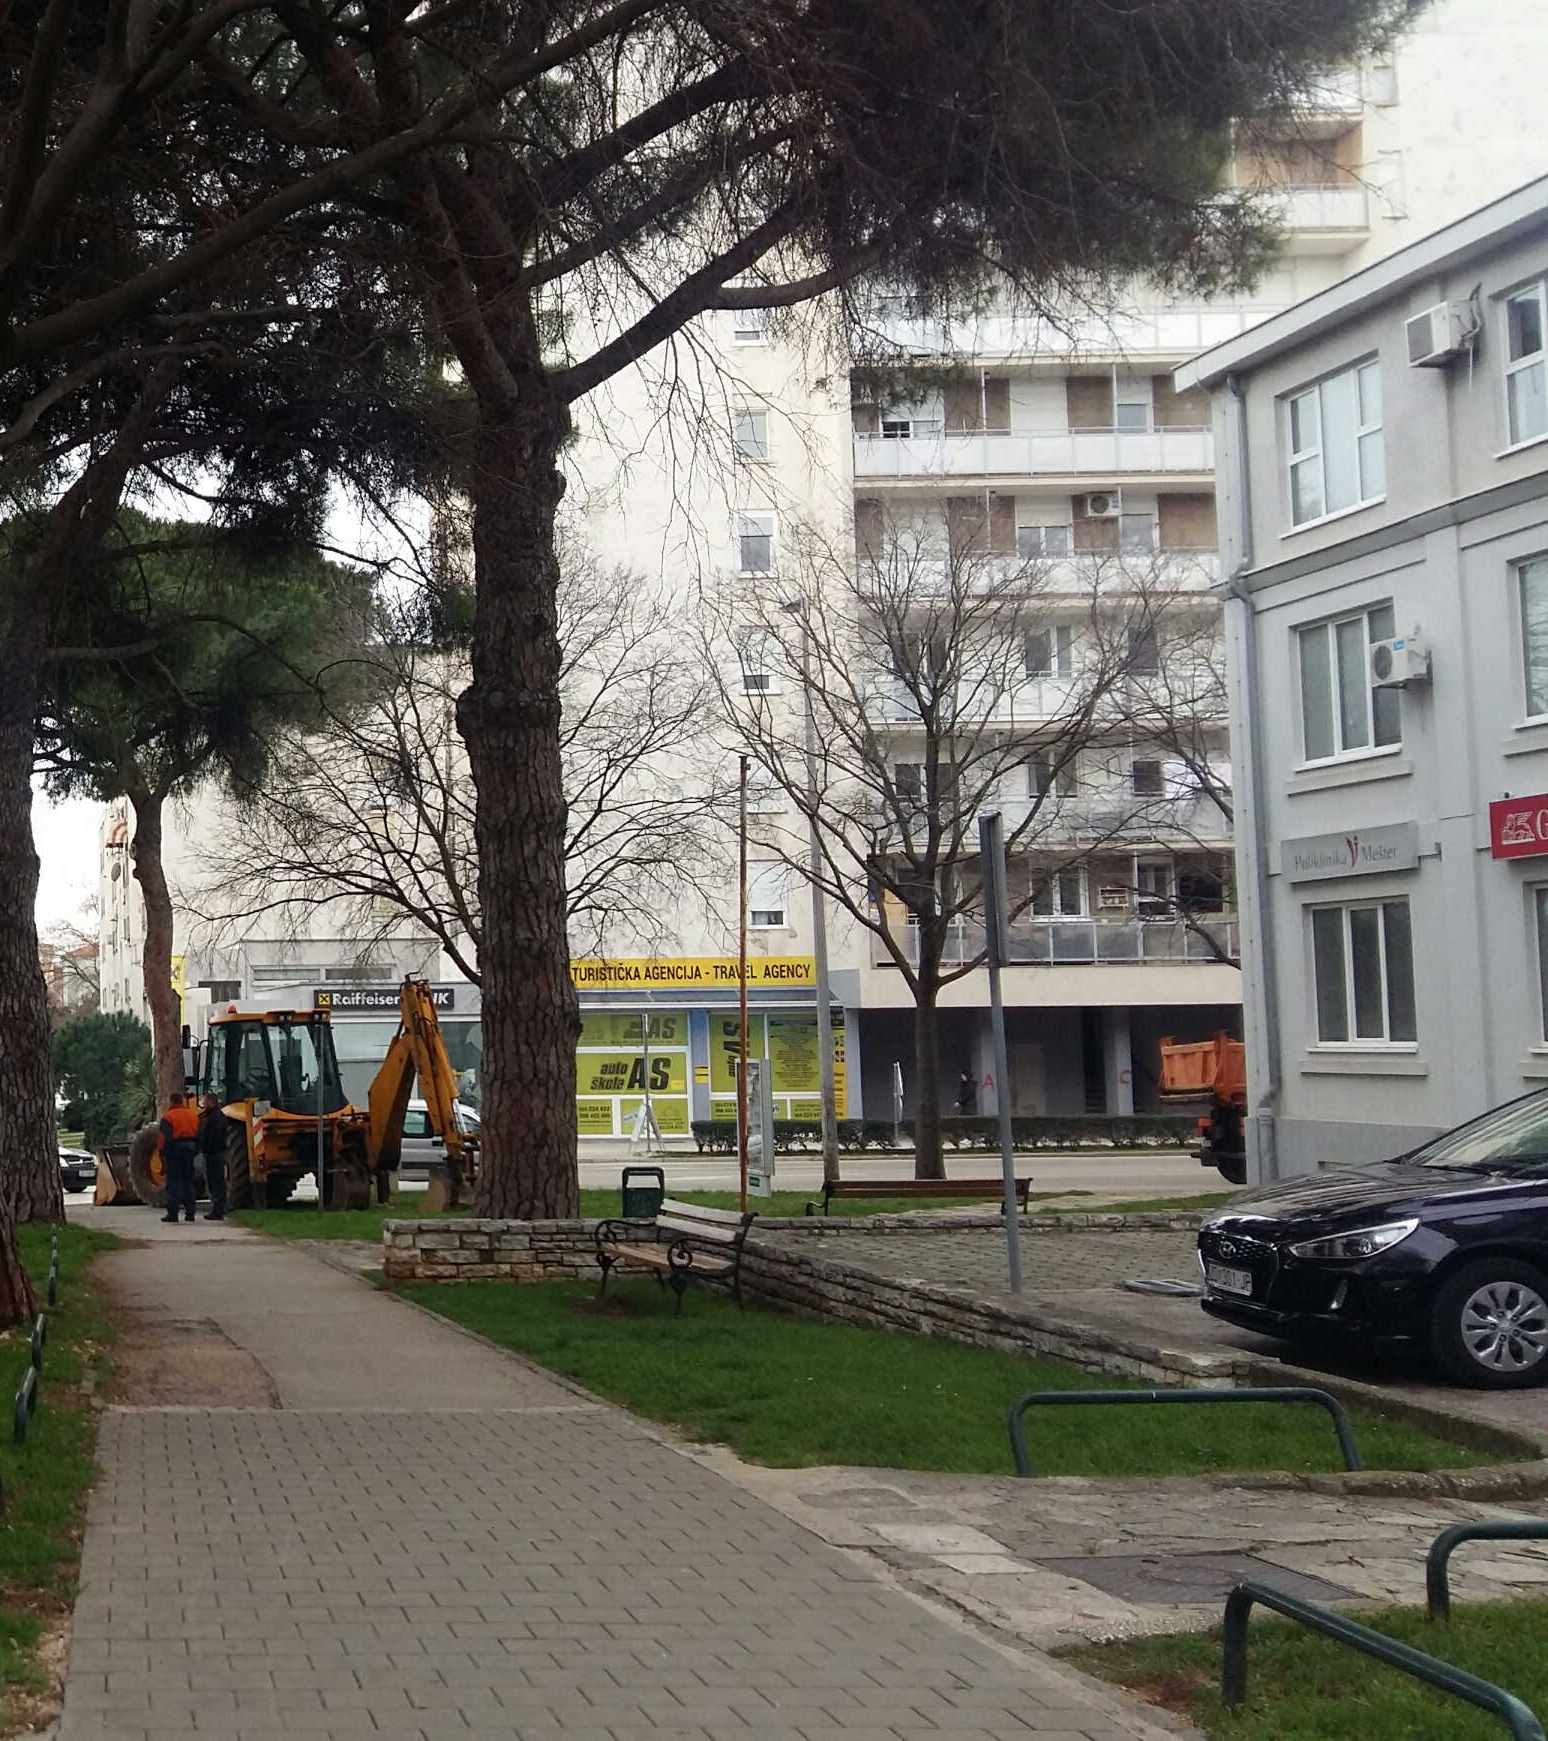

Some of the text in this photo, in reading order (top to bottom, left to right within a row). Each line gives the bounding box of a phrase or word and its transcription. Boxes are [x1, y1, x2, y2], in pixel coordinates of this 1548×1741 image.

[1294, 849, 1347, 870] Poliklinika
[572, 963, 641, 981] TURISTIČKA
[644, 965, 702, 980] AGENCIJA
[763, 963, 811, 979] AGENCY
[600, 1061, 629, 1075] auto
[626, 1057, 672, 1090] AS
[590, 1076, 625, 1090] škola
